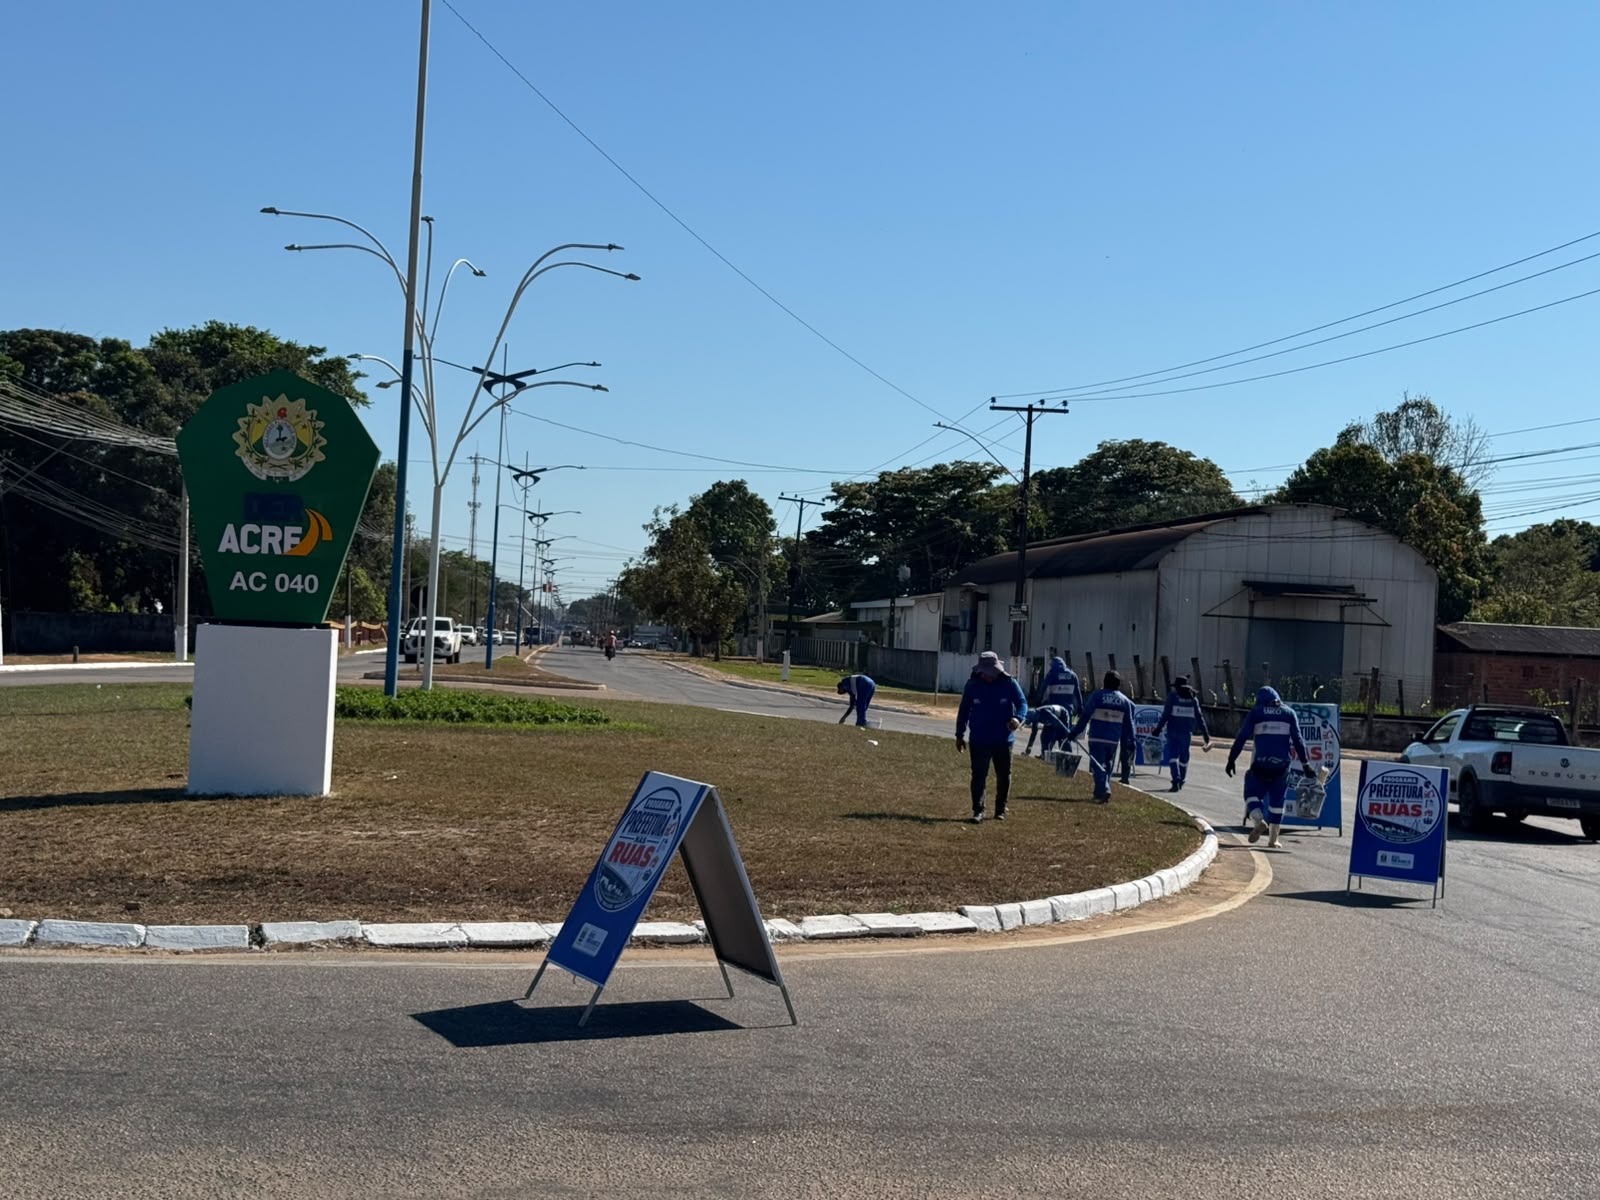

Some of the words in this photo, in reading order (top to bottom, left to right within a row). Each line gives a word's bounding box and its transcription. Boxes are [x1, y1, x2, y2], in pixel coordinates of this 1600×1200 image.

[217, 523, 303, 555] ACRE
[229, 571, 267, 592] AC
[274, 572, 319, 594] 040
[1368, 782, 1424, 799] PREFEITURA
[1368, 803, 1422, 817] RUAS
[622, 809, 672, 837] PREFEITURA
[609, 841, 655, 867] RUAS
